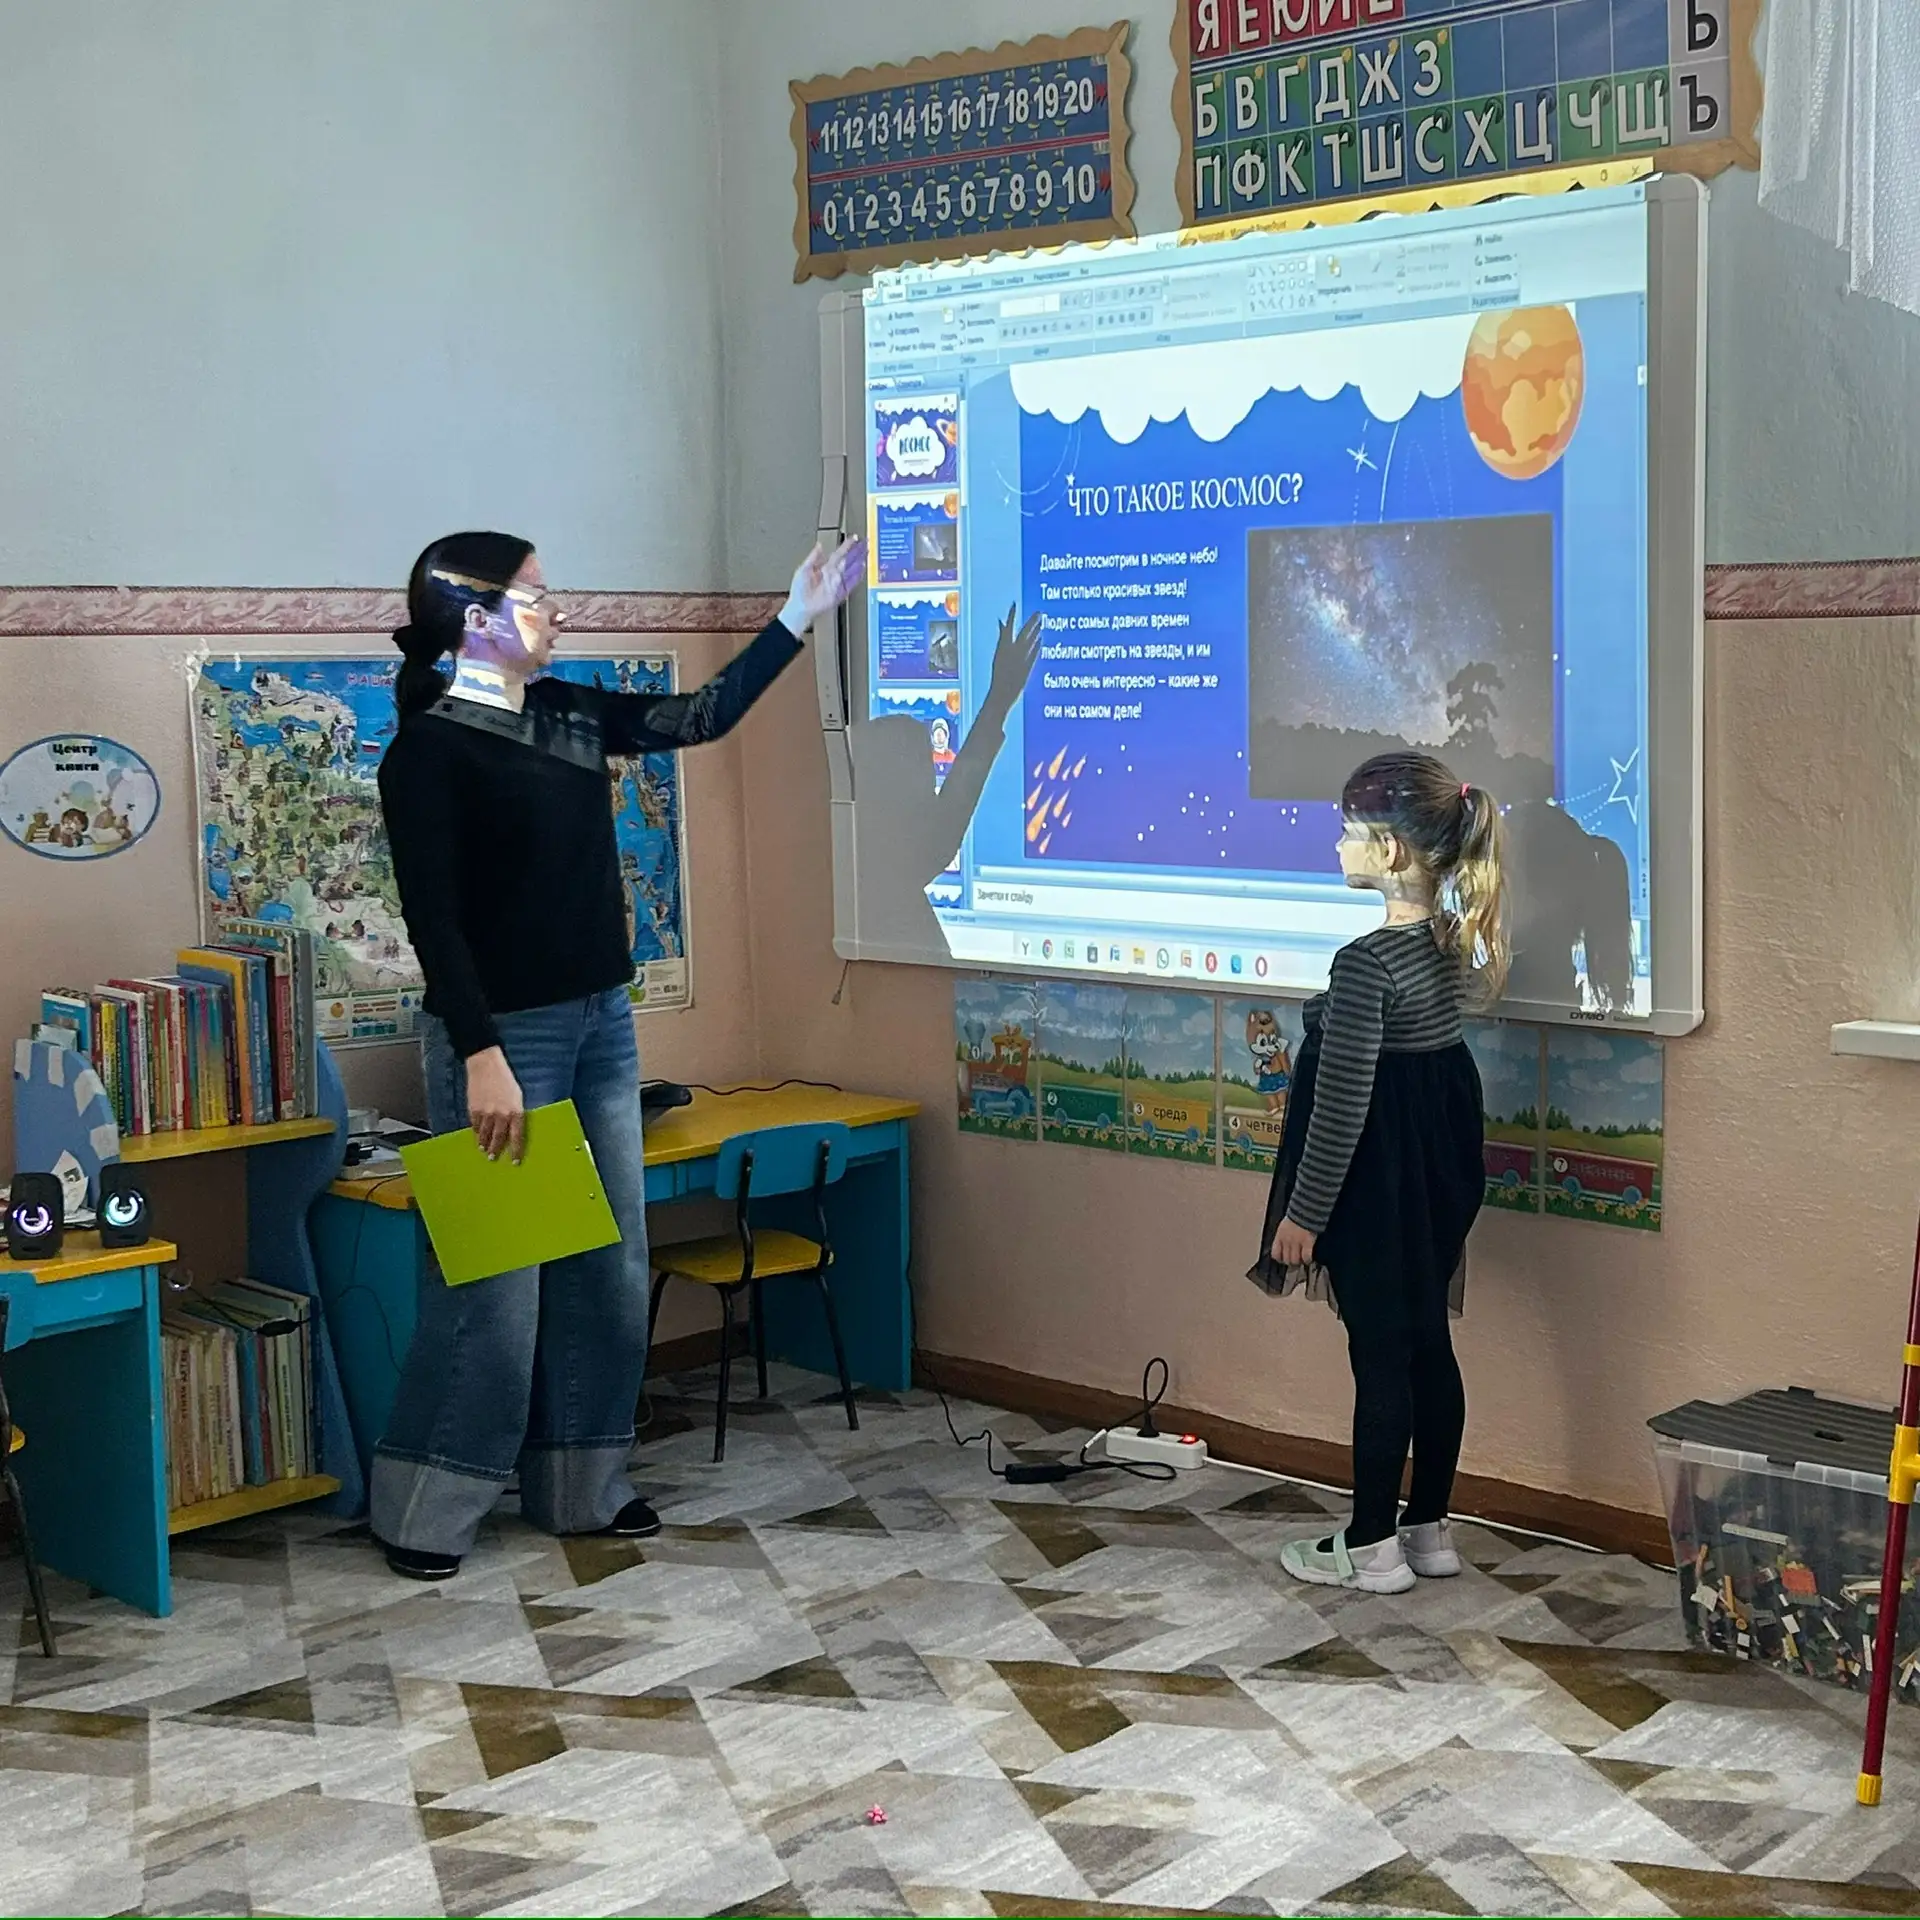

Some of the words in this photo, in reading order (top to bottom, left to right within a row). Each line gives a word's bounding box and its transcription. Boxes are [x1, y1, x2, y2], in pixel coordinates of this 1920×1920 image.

[1197, 0, 1220, 52] Я
[1195, 82, 1218, 138] Б
[1235, 75, 1258, 130] В
[1278, 65, 1300, 122] Г
[1315, 56, 1350, 124] Д
[1357, 50, 1400, 107] Ж
[820, 120, 839, 154] 11
[843, 116, 864, 149] 12
[867, 111, 890, 145] 13
[892, 105, 916, 142] 14
[920, 101, 943, 137] 15
[947, 96, 971, 132] 16
[976, 91, 1000, 128] 17
[1003, 87, 1030, 125] 18
[1033, 82, 1060, 119] 19
[1063, 76, 1094, 116] 20
[1195, 153, 1221, 209] П
[1231, 149, 1266, 202] Ф
[1277, 139, 1307, 196] К
[1322, 131, 1349, 188] Т
[1361, 123, 1403, 183] Ш
[1414, 114, 1445, 174] С
[1463, 105, 1498, 168] Х
[1514, 97, 1552, 163] Ц
[1569, 89, 1600, 148] Ч
[1617, 79, 1668, 146] Щ
[1679, 75, 1719, 133] Ъ
[823, 199, 838, 236] 0
[844, 196, 855, 232] 1
[865, 193, 880, 230] 2
[887, 190, 903, 227] 3
[911, 186, 927, 223] 4
[936, 183, 952, 221] 5
[960, 179, 976, 218] 6
[984, 176, 1001, 214] 7
[1008, 172, 1026, 212] 8
[1035, 168, 1053, 208] 9
[1062, 163, 1096, 205] 10
[1067, 486, 1110, 518] ЧТО
[1113, 480, 1185, 515] ТАКОЕ
[1190, 472, 1304, 510] КОСМОС?
[1040, 553, 1084, 573] Давайте
[1085, 553, 1140, 571] посмотрим
[1141, 554, 1148, 567] в
[1150, 552, 1188, 567] ночное
[1190, 546, 1219, 565] небо!
[1040, 583, 1061, 600] Там
[1062, 584, 1101, 600] столько
[1103, 582, 1152, 601] красивых
[1154, 579, 1188, 598] звезд!
[1040, 614, 1068, 633] Люди
[1069, 617, 1077, 629] с
[1077, 616, 1110, 629] самых
[1112, 615, 1149, 630] давних
[1151, 613, 1190, 631] времен
[1040, 644, 1080, 660] любили
[1080, 644, 1128, 662] смотреть
[1129, 645, 1142, 658] на
[1144, 644, 1185, 661] звезды,
[1187, 644, 1195, 657] и
[1196, 644, 1211, 657] им
[1043, 673, 1070, 688] было
[1071, 675, 1100, 689] очень
[1102, 674, 1156, 691] интересно
[1168, 675, 1201, 688] какие
[1202, 675, 1219, 688] же
[1044, 704, 1062, 719] они
[1064, 704, 1078, 718] на
[1079, 704, 1111, 719] самом
[1113, 702, 1142, 720] деле!
[52, 743, 98, 756] Центр
[55, 763, 99, 771] книги
[1569, 1011, 1605, 1021] DYMO
[1049, 1093, 1056, 1104] 2
[1136, 1104, 1143, 1115] 3
[1152, 1105, 1188, 1122] среда
[1231, 1117, 1239, 1128] 4
[1557, 1159, 1564, 1172] 7
